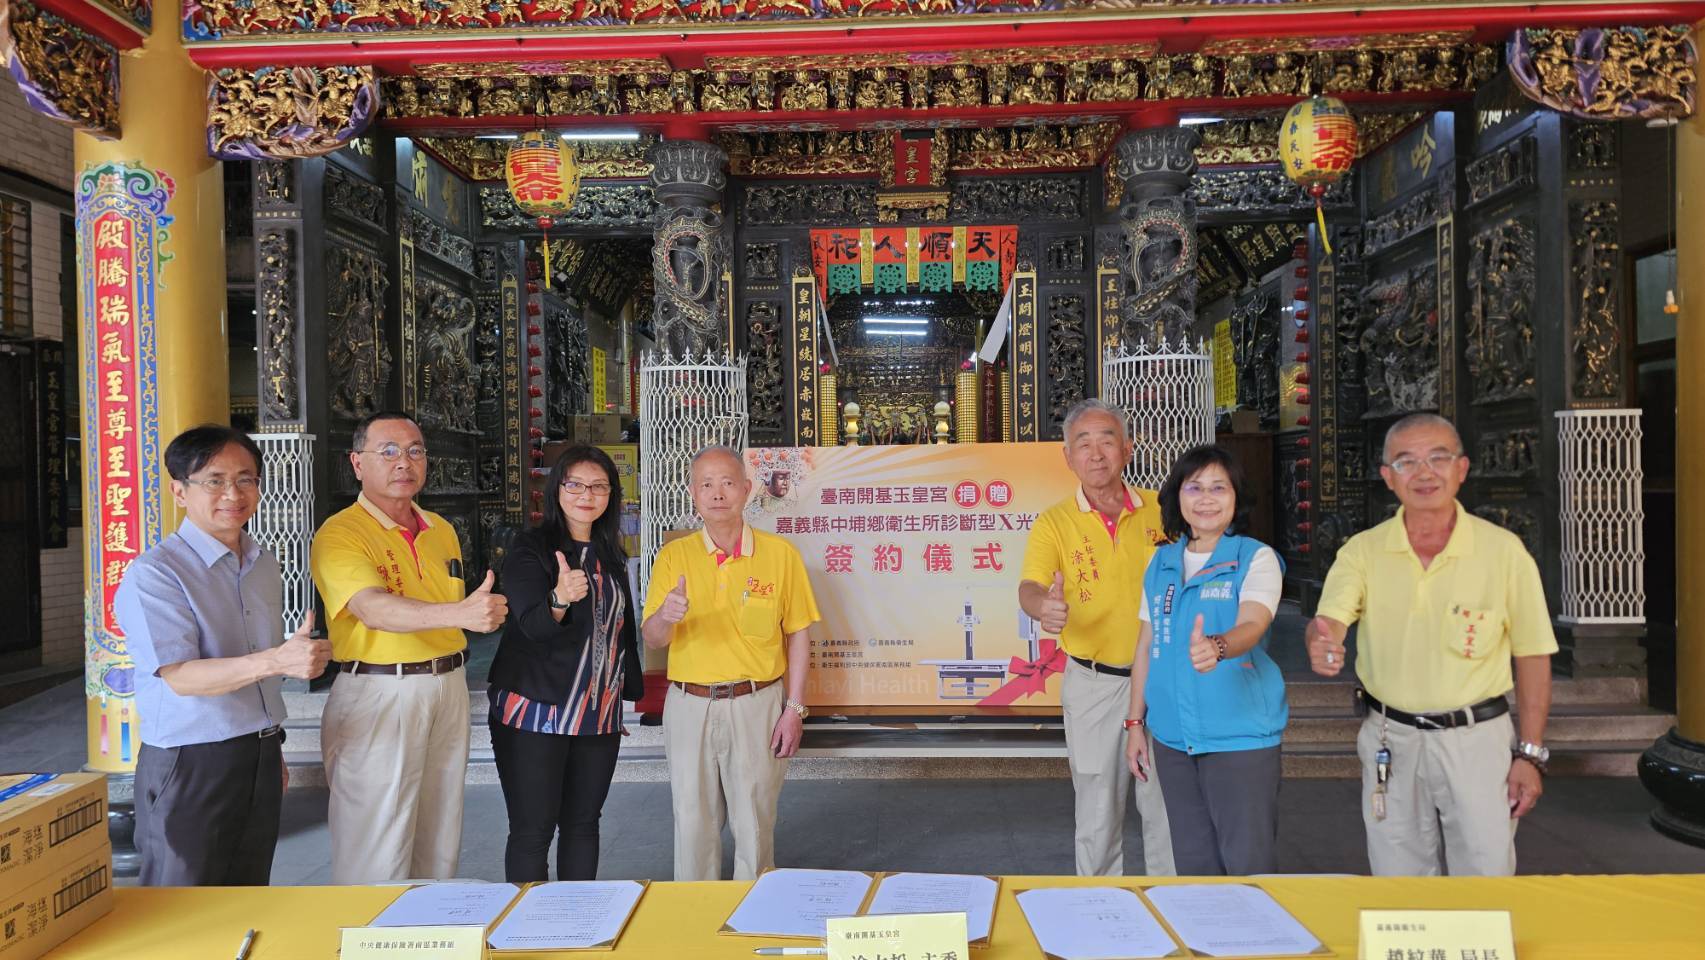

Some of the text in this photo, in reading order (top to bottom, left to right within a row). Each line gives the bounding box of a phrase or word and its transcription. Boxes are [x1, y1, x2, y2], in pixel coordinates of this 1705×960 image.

[905, 139, 920, 183] 皇宮
[97, 220, 137, 629] 殿騰瑞氣至尊至聖護群
[820, 486, 948, 505] 臺南開基玉皇宮
[775, 513, 1039, 534] 嘉義縣中埔鄉衛生所診斷型X光
[824, 542, 1003, 573] 簽約儀式
[860, 672, 929, 695] Health
